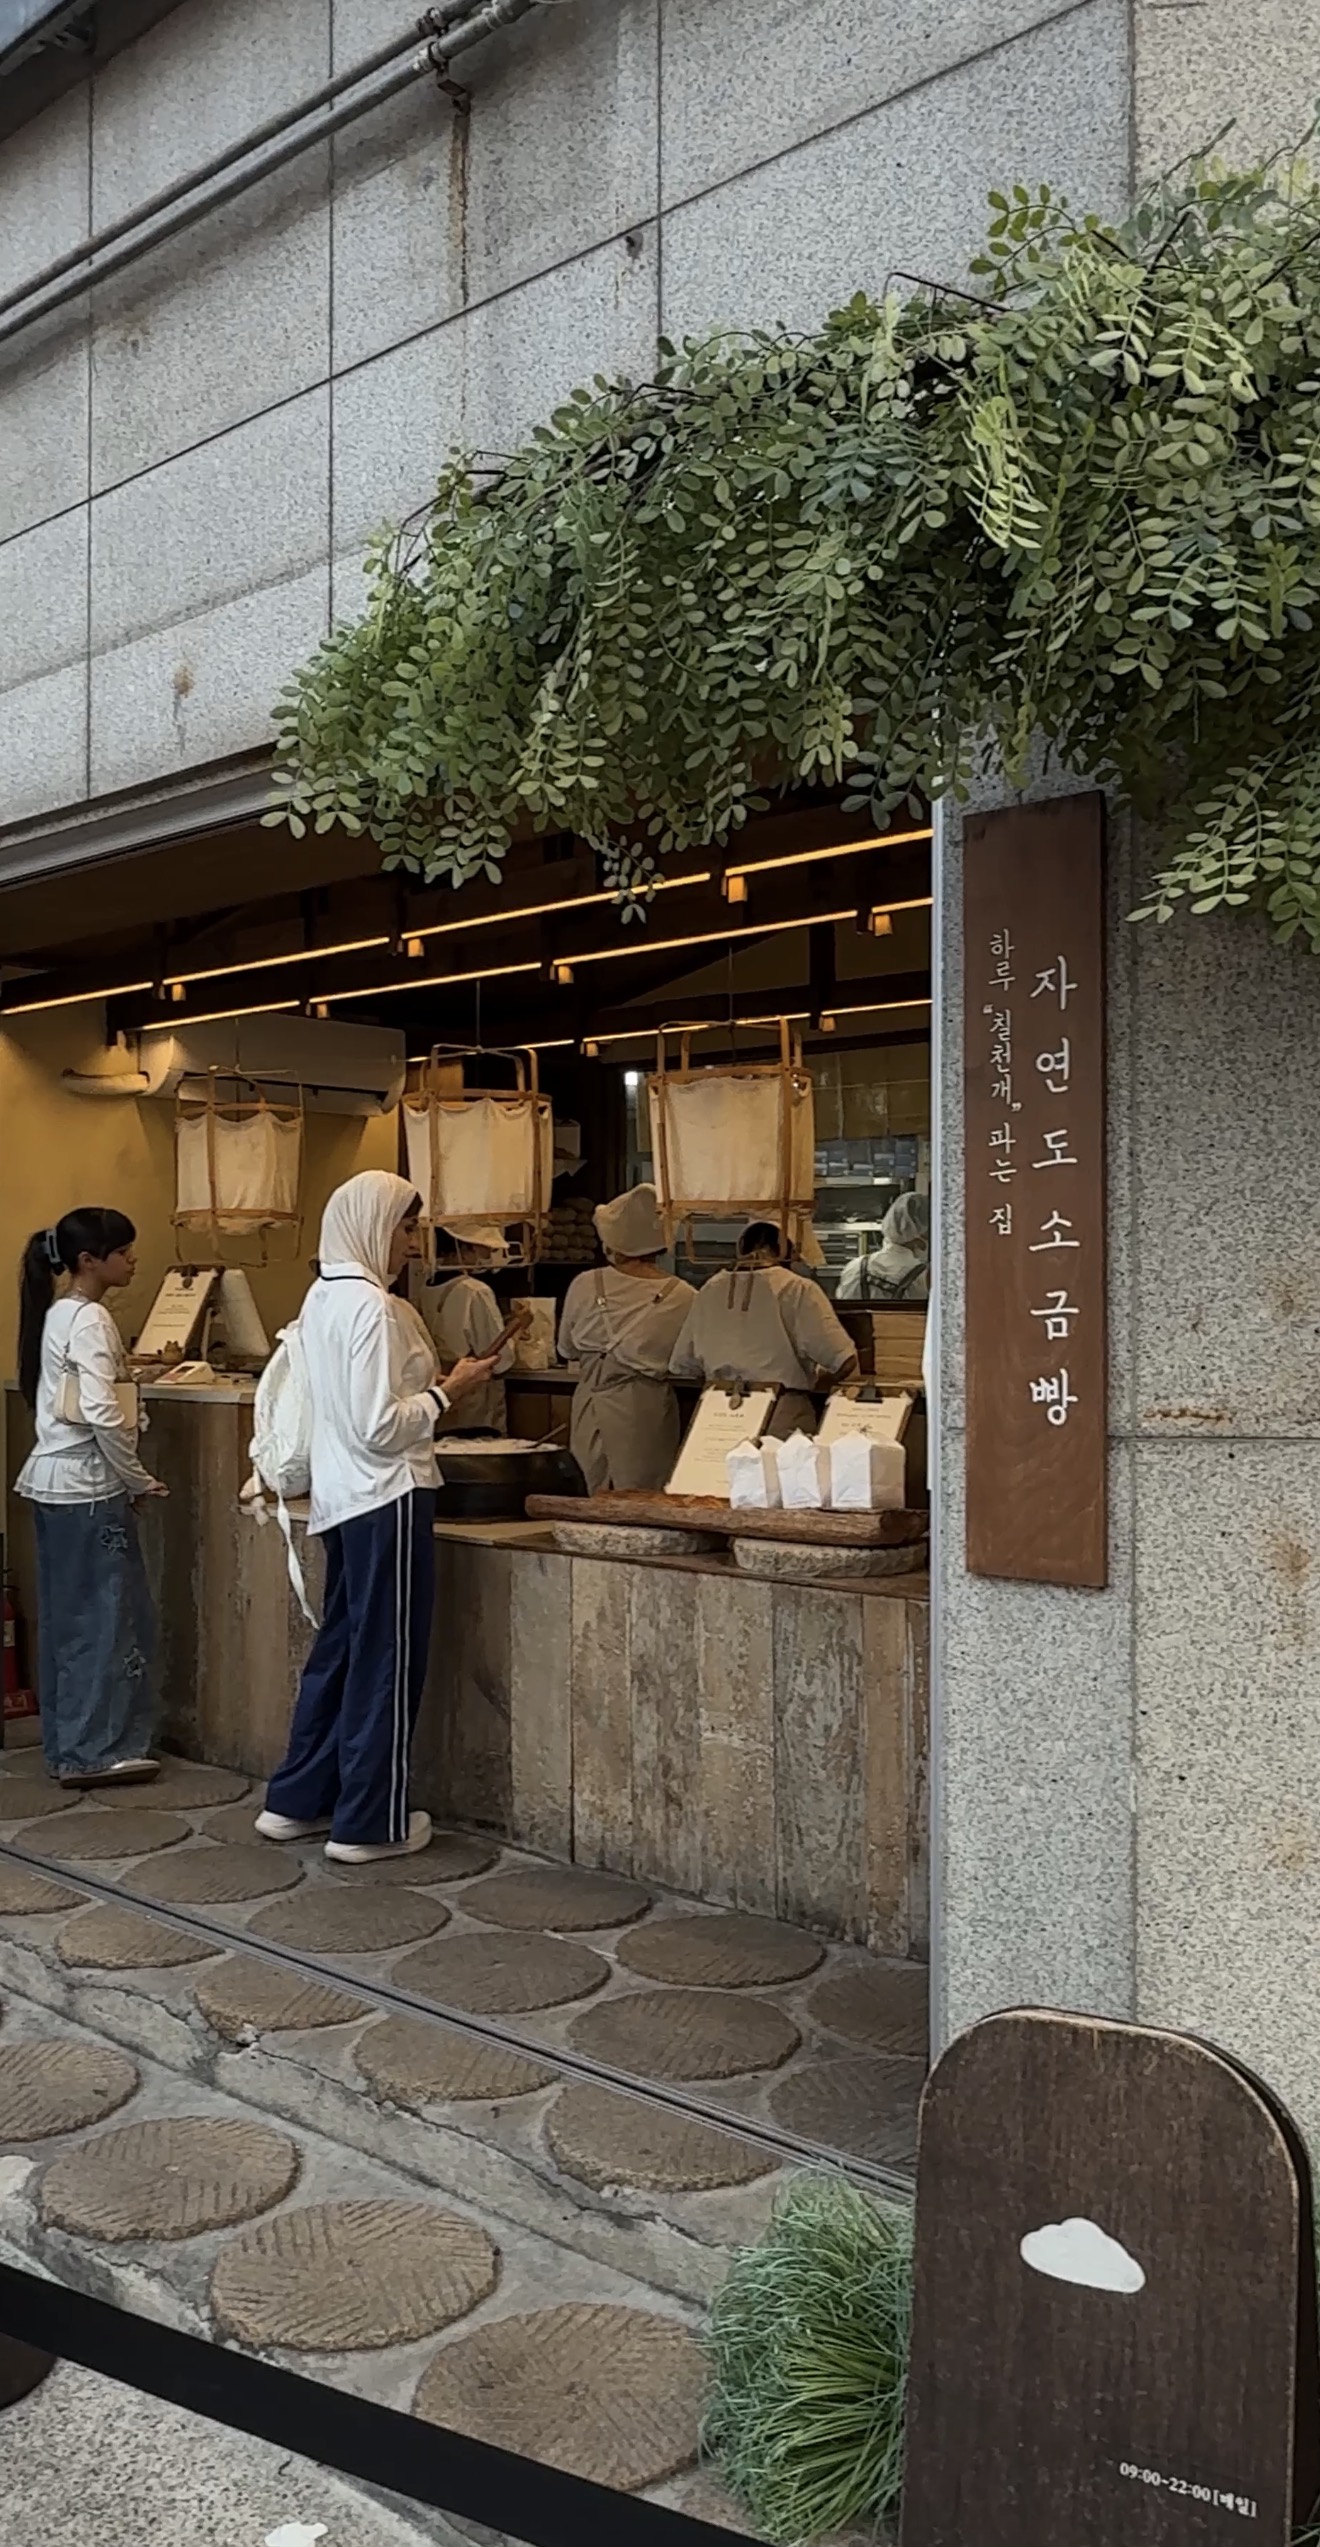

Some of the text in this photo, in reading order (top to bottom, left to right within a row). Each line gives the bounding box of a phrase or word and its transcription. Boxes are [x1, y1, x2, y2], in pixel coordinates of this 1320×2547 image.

[988, 928, 1016, 992] 하루
[988, 1121, 1018, 1183] 파는
[988, 1203, 1013, 1236] 집
